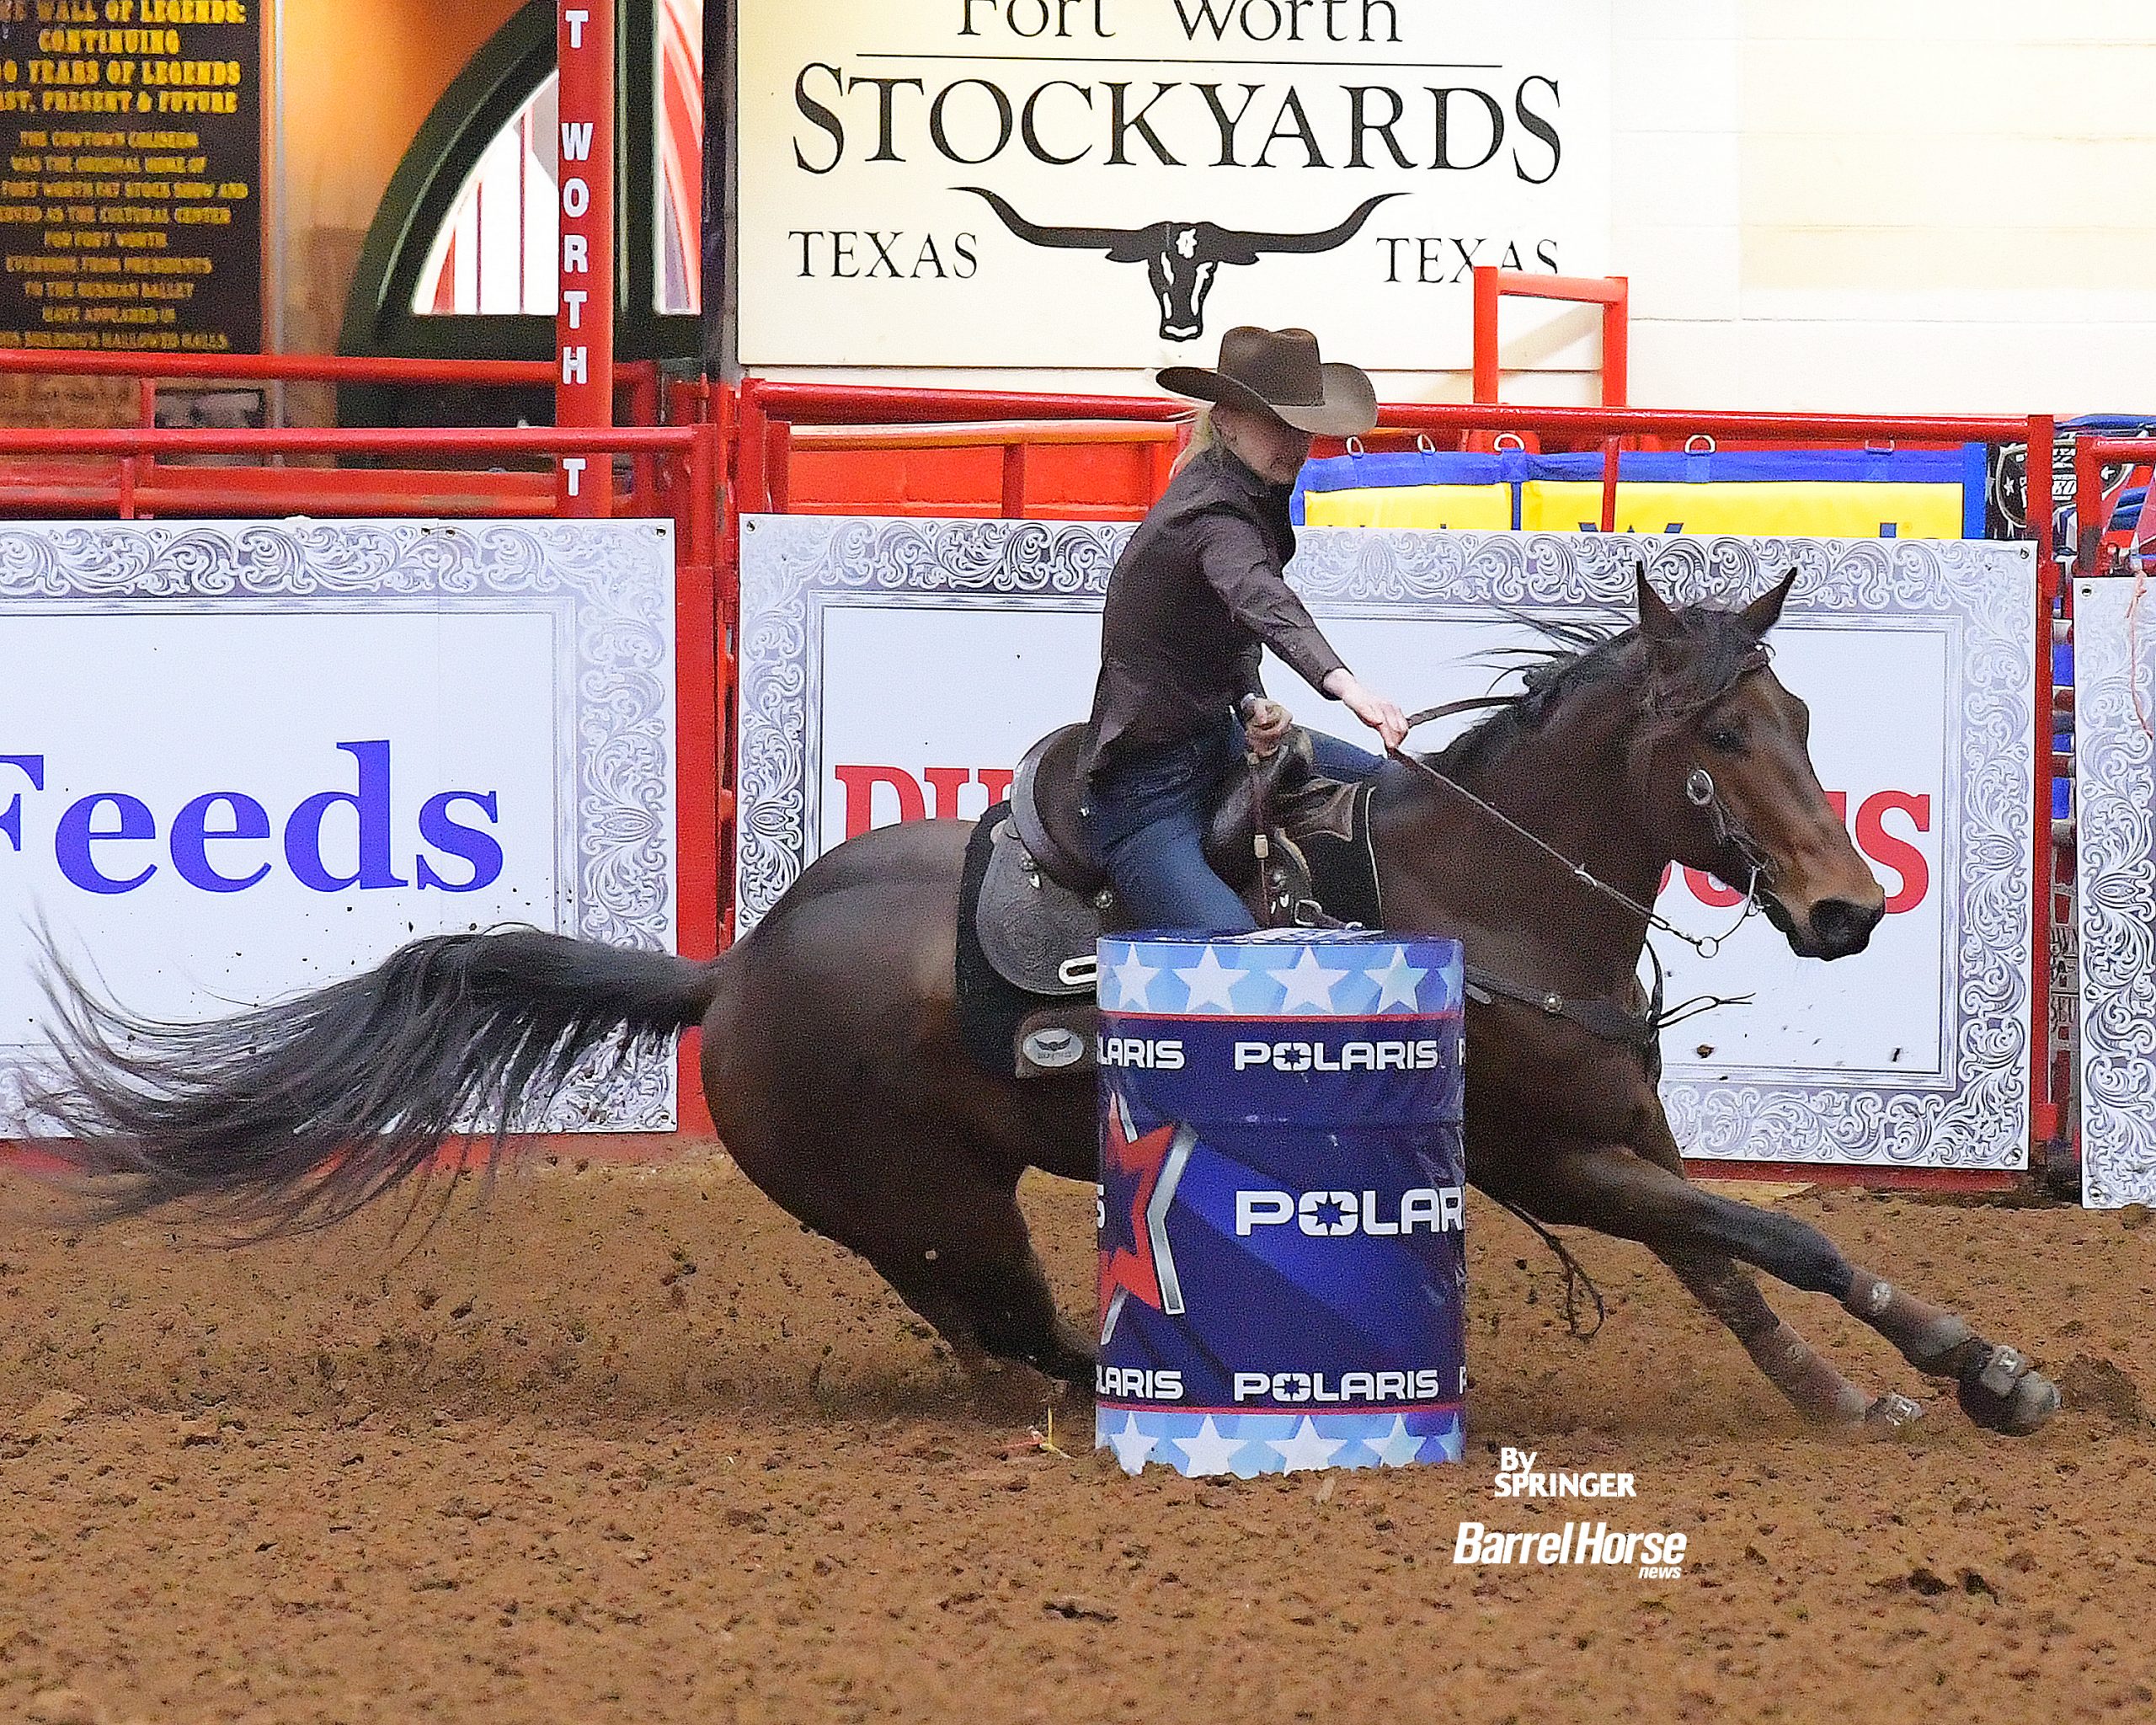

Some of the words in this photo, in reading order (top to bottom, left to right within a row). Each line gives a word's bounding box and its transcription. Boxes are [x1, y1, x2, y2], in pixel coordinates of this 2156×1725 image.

[106, 0, 133, 23] OF
[1173, 0, 1403, 41] Worth
[39, 29, 180, 55] CONTINUING
[29, 60, 99, 83] YEARS
[107, 61, 135, 84] OF
[141, 61, 241, 85] LEGENDS
[42, 90, 132, 113] PRESENT
[158, 91, 237, 114] FUTURE
[793, 62, 1561, 184] STOCKYARDS
[561, 122, 594, 385] WORTH
[788, 231, 978, 279] TEXAS
[1375, 237, 1559, 284] TEXAS
[1234, 1039, 1438, 1071] POLARIS
[1233, 1370, 1438, 1402] POLARIS
